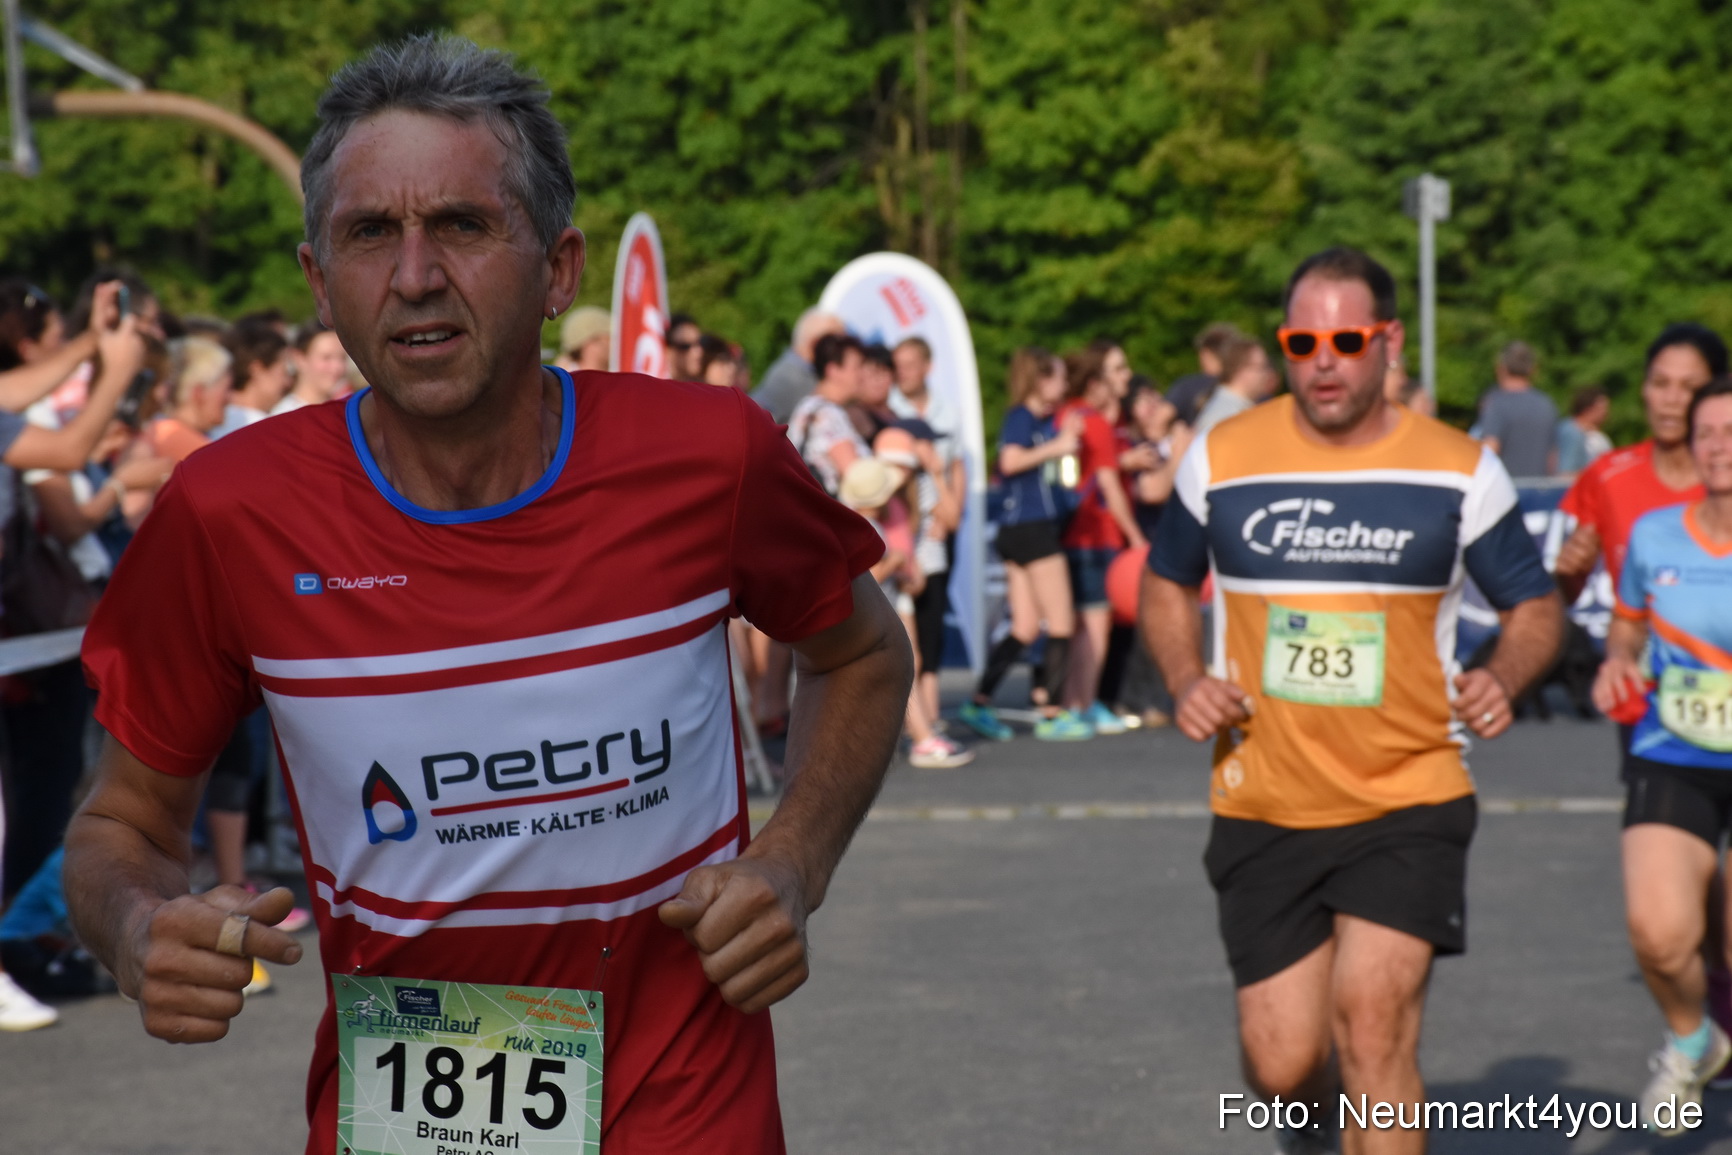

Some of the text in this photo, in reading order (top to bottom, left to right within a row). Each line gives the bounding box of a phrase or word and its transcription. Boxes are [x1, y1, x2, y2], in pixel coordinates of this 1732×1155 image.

[1271, 518, 1414, 550] Fischer
[1283, 548, 1402, 565] AUTOMOBILE
[1286, 643, 1354, 679] 783
[1675, 697, 1732, 726] 191
[421, 718, 671, 801] Petry
[615, 785, 670, 819] KLIMA
[505, 990, 550, 1007] Gesunde
[379, 1011, 482, 1035] firmenlauf
[380, 1027, 424, 1037] neumarkt
[541, 1039, 587, 1058] 2019
[376, 1042, 567, 1131] 1815
[416, 1120, 519, 1149] Braun Karl
